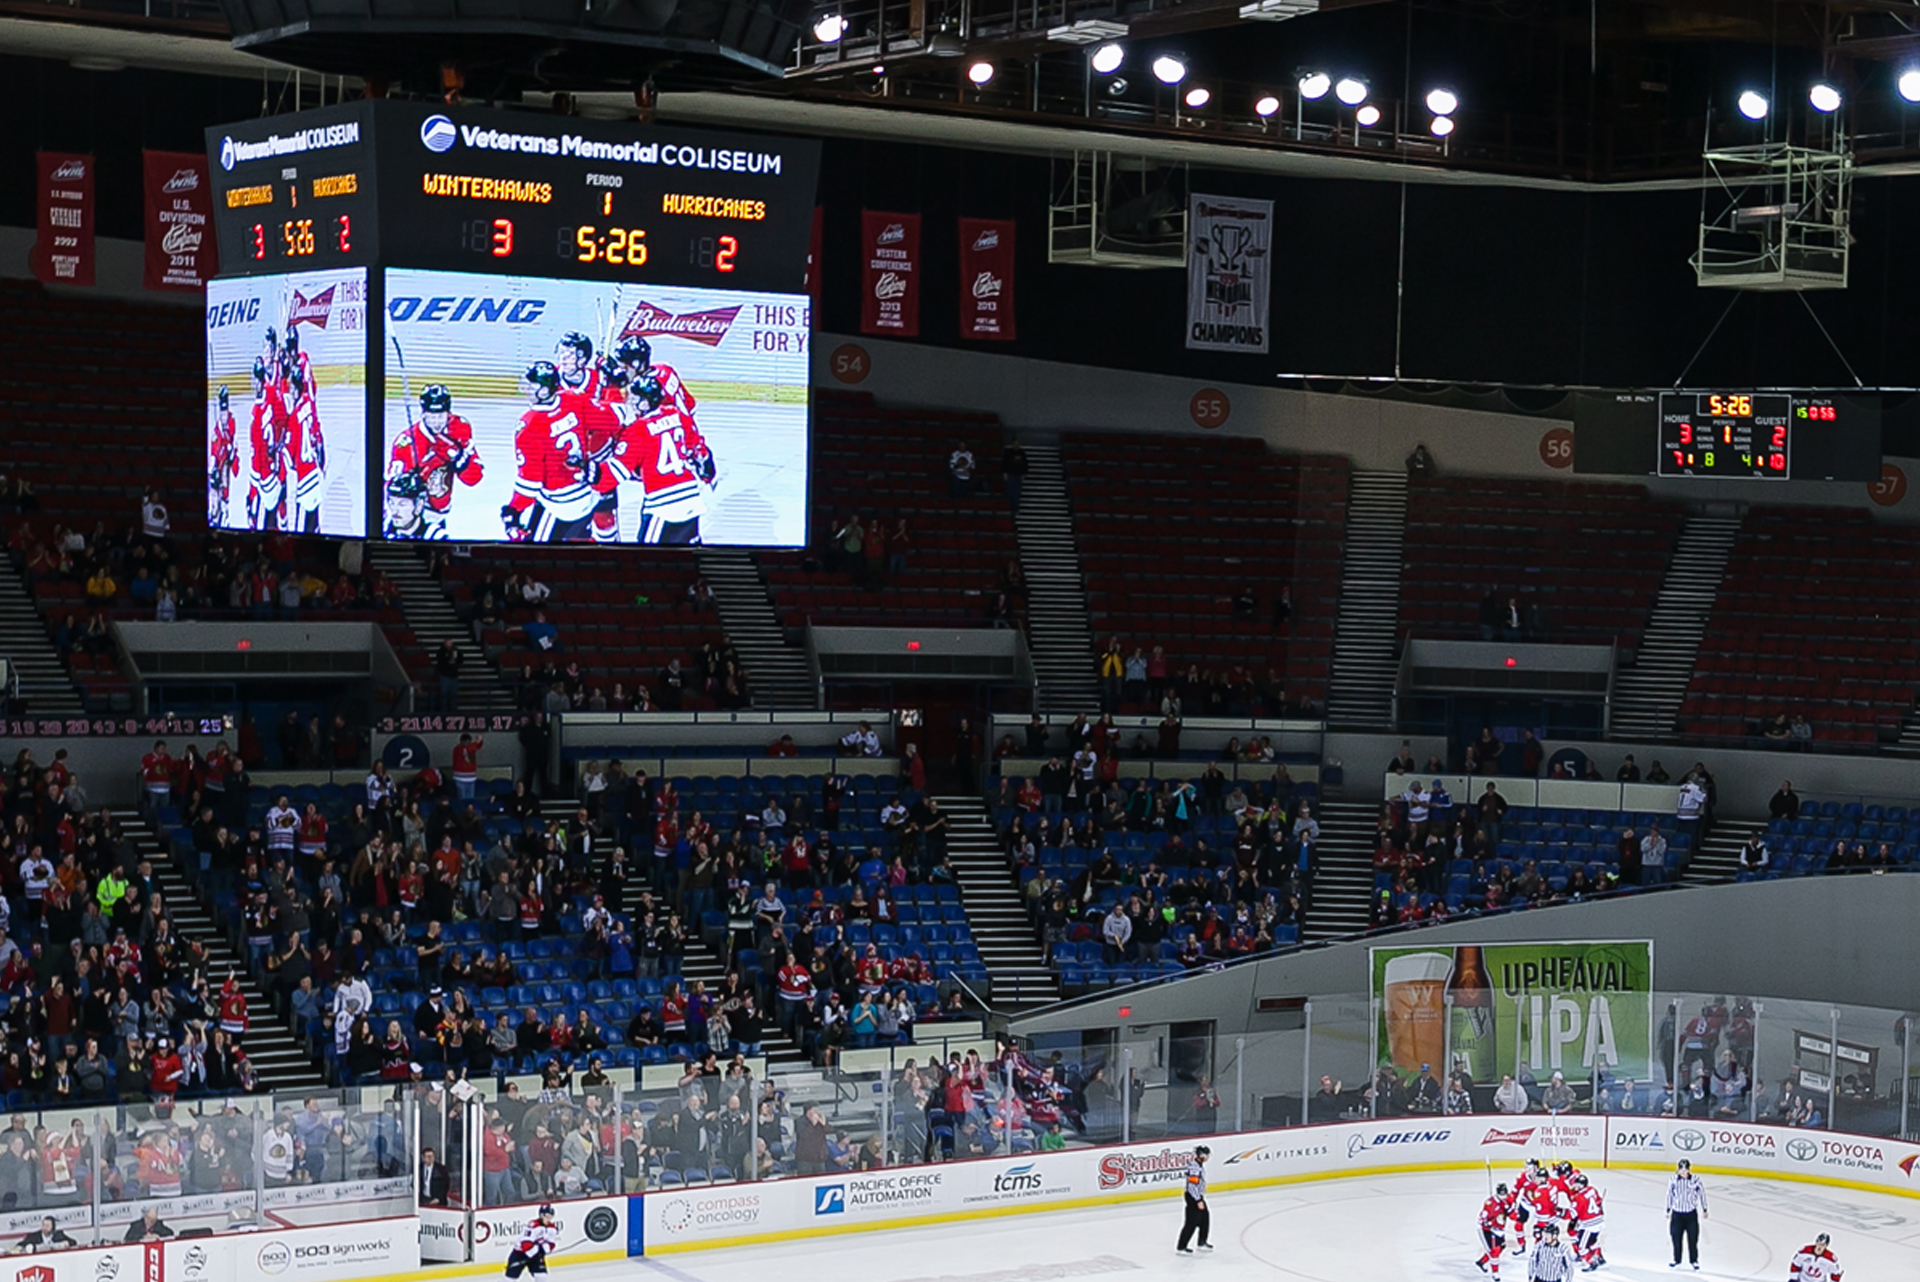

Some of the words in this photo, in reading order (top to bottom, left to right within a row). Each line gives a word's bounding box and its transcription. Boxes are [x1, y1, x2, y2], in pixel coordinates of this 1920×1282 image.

[306, 122, 360, 150] COLISEUM
[460, 124, 559, 155] Veterans
[561, 135, 659, 164] Memorial
[660, 144, 782, 175] COLISEUM
[586, 173, 623, 188] PERIOD
[290, 185, 297, 208] 1
[423, 173, 553, 204] WINTERHAWKS
[603, 191, 613, 216] 1
[662, 193, 766, 220] HURRICANES
[159, 211, 205, 225] DIVISION
[253, 223, 265, 260] 3
[284, 219, 314, 257] 5:26
[339, 214, 351, 253] 2
[492, 218, 514, 257] 3
[577, 225, 648, 266] 5:26
[715, 235, 739, 272] 2
[170, 255, 195, 267] 2011
[876, 248, 907, 259] WESTERN
[870, 259, 912, 271] CONFERENCE
[880, 301, 901, 312] 2013
[977, 301, 997, 311] 2013
[627, 309, 731, 336] Budweiser
[754, 304, 796, 327] THIS
[753, 331, 790, 352] FOR
[1191, 321, 1263, 346] CHAMPIONS
[836, 355, 862, 374] 54
[1196, 399, 1222, 416] 55
[1710, 394, 1751, 416] 5:26
[1664, 414, 1690, 423] HOME
[1755, 416, 1787, 426] GUEST
[1679, 423, 1692, 444] 3
[1723, 425, 1731, 444] 1
[1772, 425, 1786, 446] 2
[1547, 440, 1571, 457] 56
[1704, 452, 1715, 467] 8
[1742, 454, 1751, 467] 4
[1875, 475, 1898, 494] 57
[199, 718, 222, 734] 25
[492, 716, 513, 730] 17
[399, 747, 414, 768] 2
[1564, 761, 1575, 778] 5
[1503, 956, 1634, 998] UPHEAVAL
[1530, 994, 1620, 1071] IPA
[1372, 1130, 1451, 1145] BOEING
[1540, 1126, 1560, 1136] THS
[1562, 1127, 1589, 1136] BUD'S
[1615, 1132, 1649, 1146] DAY
[1710, 1130, 1776, 1148] TOYOTA
[1256, 1153, 1270, 1162] LA
[1276, 1146, 1328, 1159] FITNESS
[1711, 1145, 1731, 1154] Let's
[1733, 1147, 1746, 1156] Go
[1750, 1148, 1776, 1158] Places
[1822, 1140, 1884, 1161] TOYOTA
[1099, 1149, 1197, 1190] Standar
[1823, 1155, 1842, 1165] Let's
[1844, 1158, 1856, 1167] Go
[1857, 1158, 1884, 1171] Places
[850, 1177, 897, 1193] PACIFIC
[899, 1173, 942, 1188] OFFICE
[994, 1173, 1042, 1192] tcms
[1127, 1175, 1138, 1186] TV
[1140, 1174, 1148, 1184] &
[696, 1194, 760, 1212] compass
[850, 1187, 932, 1205] AUTOMATION
[696, 1209, 759, 1225] oncology
[492, 1221, 526, 1237] Medi
[294, 1245, 330, 1259] 503
[333, 1243, 355, 1256] sign
[357, 1240, 390, 1252] works
